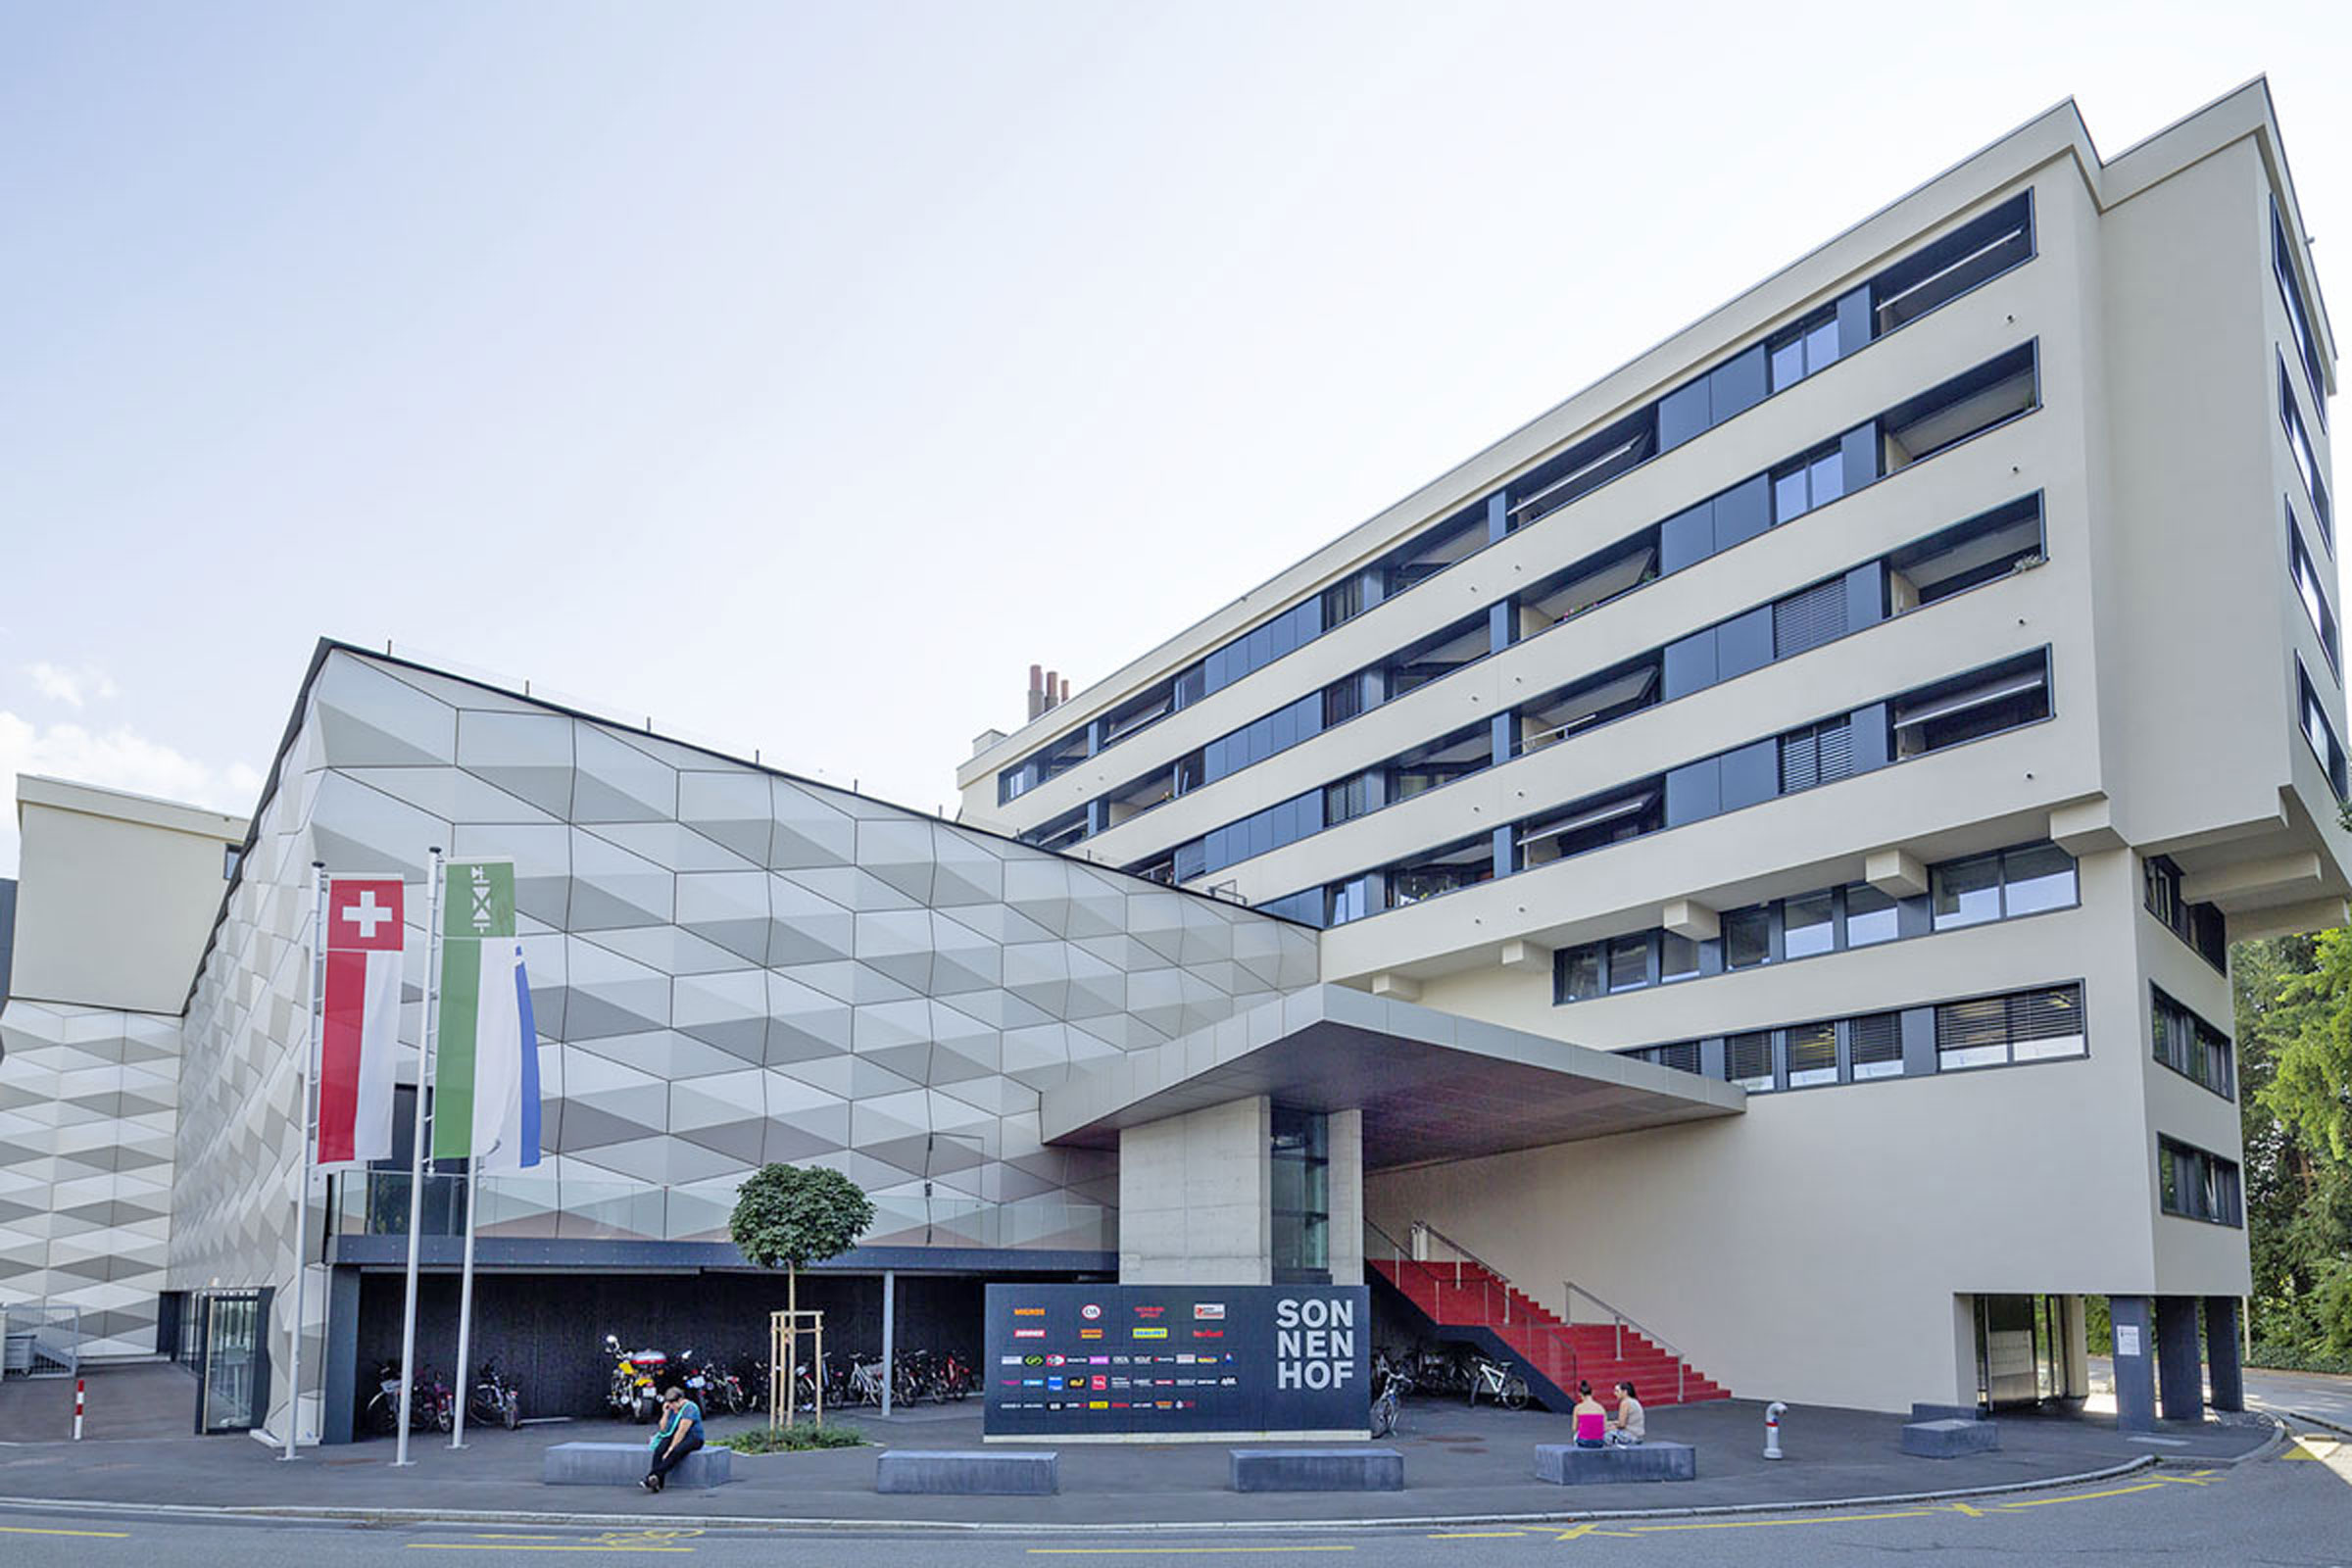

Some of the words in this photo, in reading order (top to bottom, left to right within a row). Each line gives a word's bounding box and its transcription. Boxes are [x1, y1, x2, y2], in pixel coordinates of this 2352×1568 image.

[1276, 1298, 1353, 1328] SON
[1277, 1330, 1353, 1358] NEN
[1278, 1360, 1353, 1390] HOF
